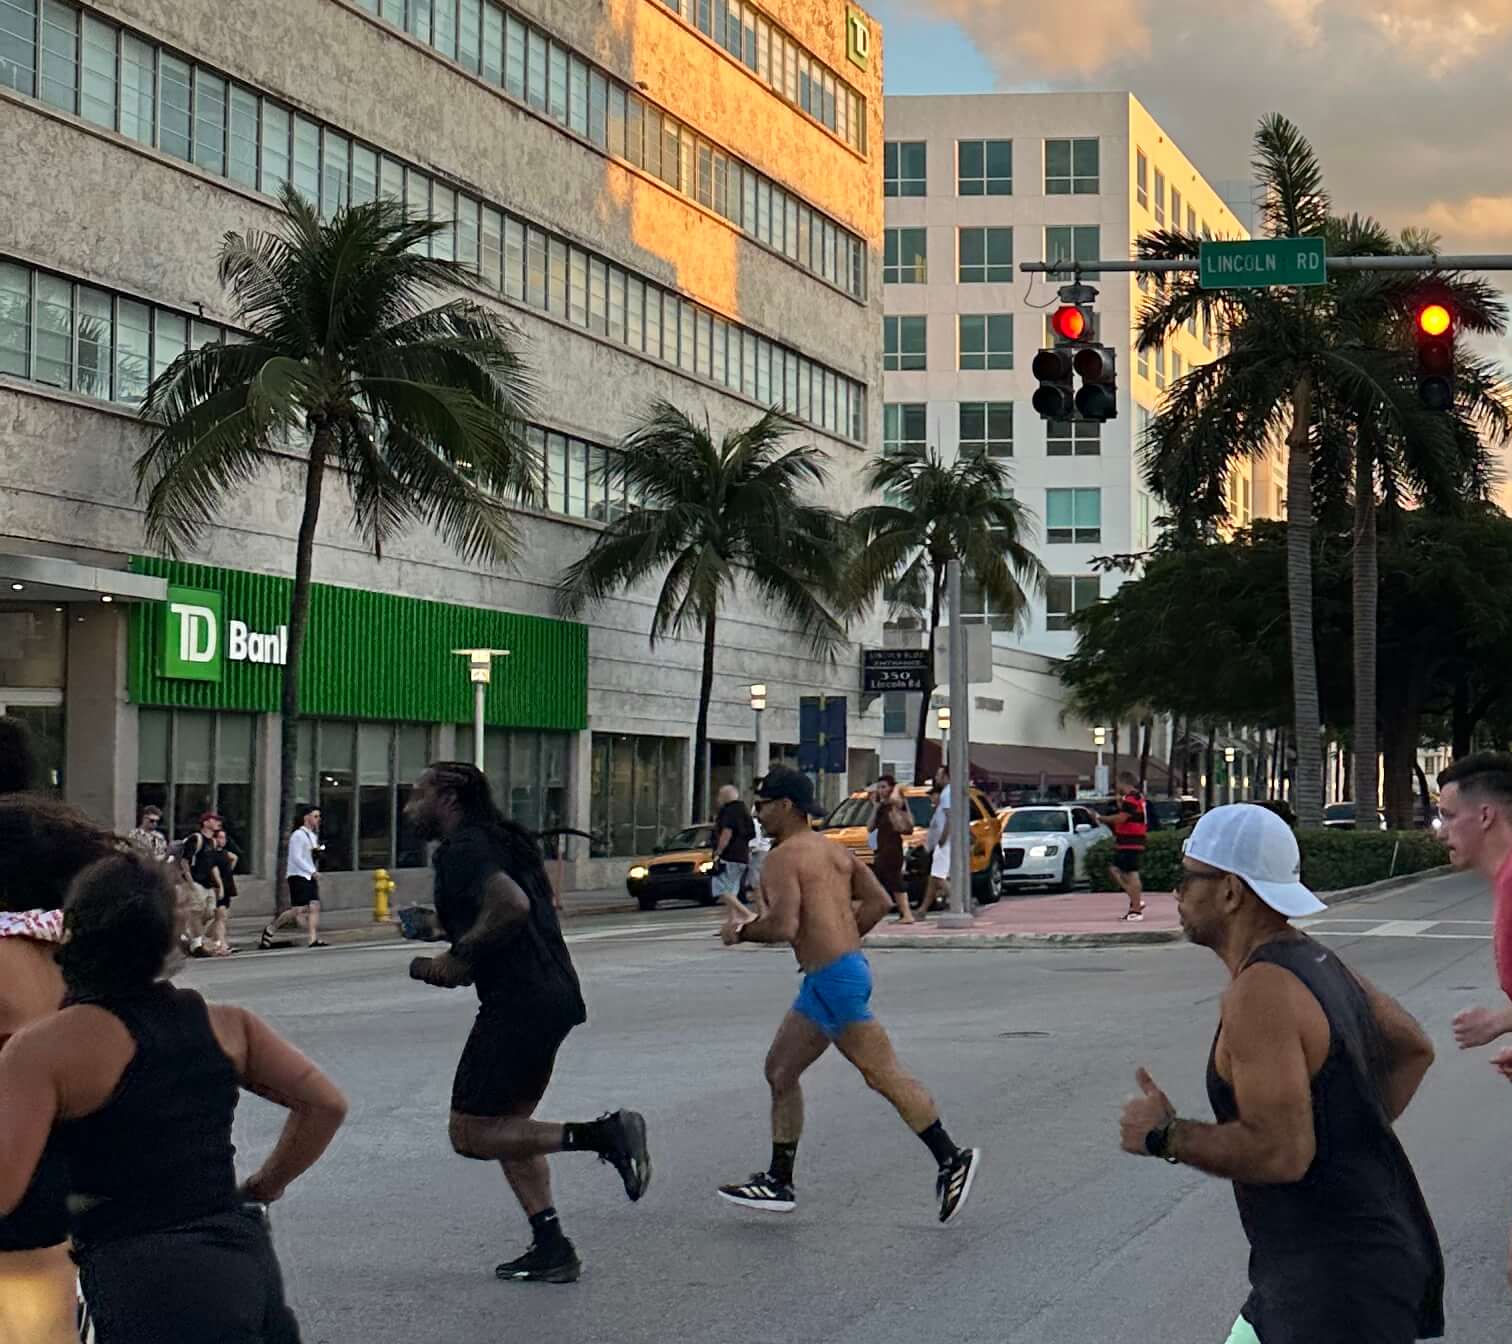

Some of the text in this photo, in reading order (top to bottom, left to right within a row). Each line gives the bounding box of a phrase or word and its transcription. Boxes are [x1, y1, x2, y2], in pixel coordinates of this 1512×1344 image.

[1207, 252, 1320, 273] LINCOLN RD
[171, 602, 217, 663] TD
[880, 671, 911, 681] 350
